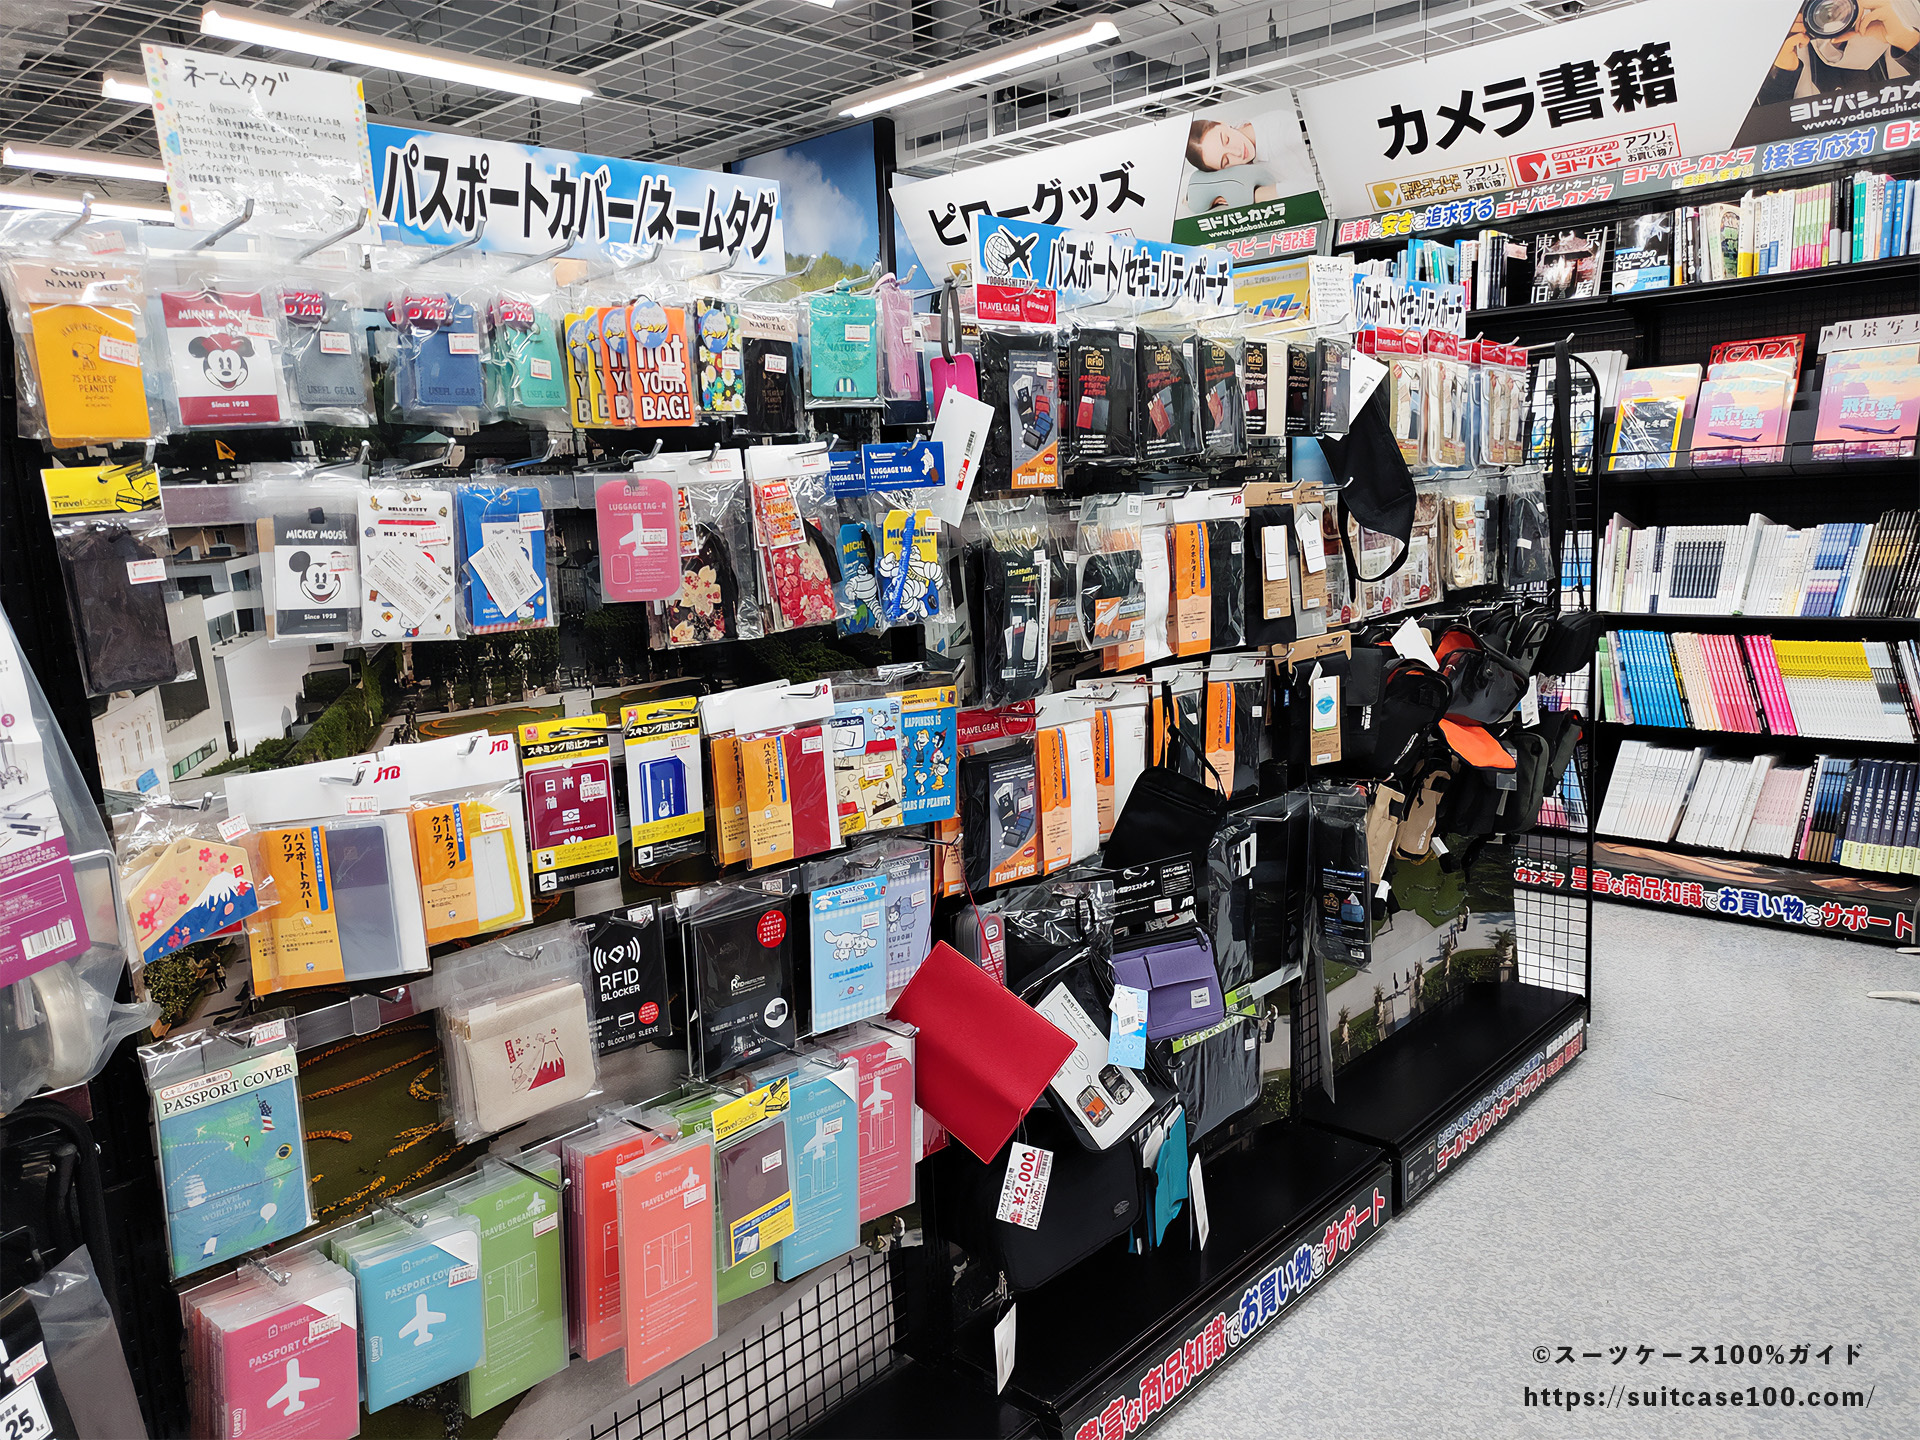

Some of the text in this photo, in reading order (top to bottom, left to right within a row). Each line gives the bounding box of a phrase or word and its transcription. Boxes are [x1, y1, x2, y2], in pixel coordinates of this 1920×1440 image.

[183, 57, 290, 97] ネームタグ
[1376, 40, 1678, 161] カメラ書籍
[1761, 127, 1878, 172] 接客応対
[1554, 151, 1622, 175] ヨドバシ
[1621, 147, 1758, 188] ヨドバシカメラ
[1495, 184, 1615, 219] ヨドバシカメラ
[1504, 175, 1608, 202] ゴールドポイントカードの
[381, 141, 776, 264] パスポートカバー/ネームタグ
[928, 160, 1146, 247] ピローグッズ
[1197, 202, 1286, 233] ヨドバシカメラ
[1208, 216, 1287, 240] www.yodobashi.com
[1339, 197, 1495, 246] 信頼と安さを追求する
[1047, 233, 1230, 307] パスポート/セキュリティポーチ
[1615, 255, 1668, 272] ドローン入門
[979, 300, 1001, 312] TRAVEL
[1354, 281, 1464, 330] パスポート/セキュリティポーチ
[1723, 342, 1797, 363] CAPA
[642, 396, 691, 421] BAG!
[1016, 472, 1056, 486] Travel Pass
[608, 502, 642, 511] LUGGAGE
[286, 529, 318, 540] MICKEY
[303, 612, 321, 620] Since
[628, 718, 696, 737] スキミング防止カード
[957, 721, 1000, 736] TRAVEL GEAR
[489, 739, 509, 755] JTB
[527, 737, 605, 756] スキミング防止カード
[373, 765, 401, 783] JTB
[763, 742, 775, 802] パスポートカバー
[431, 816, 442, 844] クリア
[442, 813, 456, 869] ネームタッグ
[281, 832, 295, 863] クリア
[233, 864, 251, 896] 日本
[293, 831, 313, 909] パスポートカバー
[994, 865, 1036, 884] Travel Pass
[1179, 895, 1195, 910] JTB
[1570, 865, 1914, 941] 豊富な商品知識でお買い物をサポート
[599, 968, 640, 993] RFID
[601, 985, 641, 1002] BLOCKER
[605, 1025, 659, 1048] BLOCKING SLEEVE
[163, 1070, 230, 1098] スキミング防止機能付き
[243, 1063, 293, 1088] COVER
[163, 1080, 240, 1114] PASSPORT
[641, 1195, 665, 1210] TRAVEL
[480, 1219, 508, 1240] TRAVEL
[384, 1274, 431, 1300] PASSPORT
[1074, 1187, 1386, 1440] 豊富な商品知識でお買い物をサポート
[248, 1339, 300, 1369] PASSPORT
[6, 1407, 35, 1440] 25
